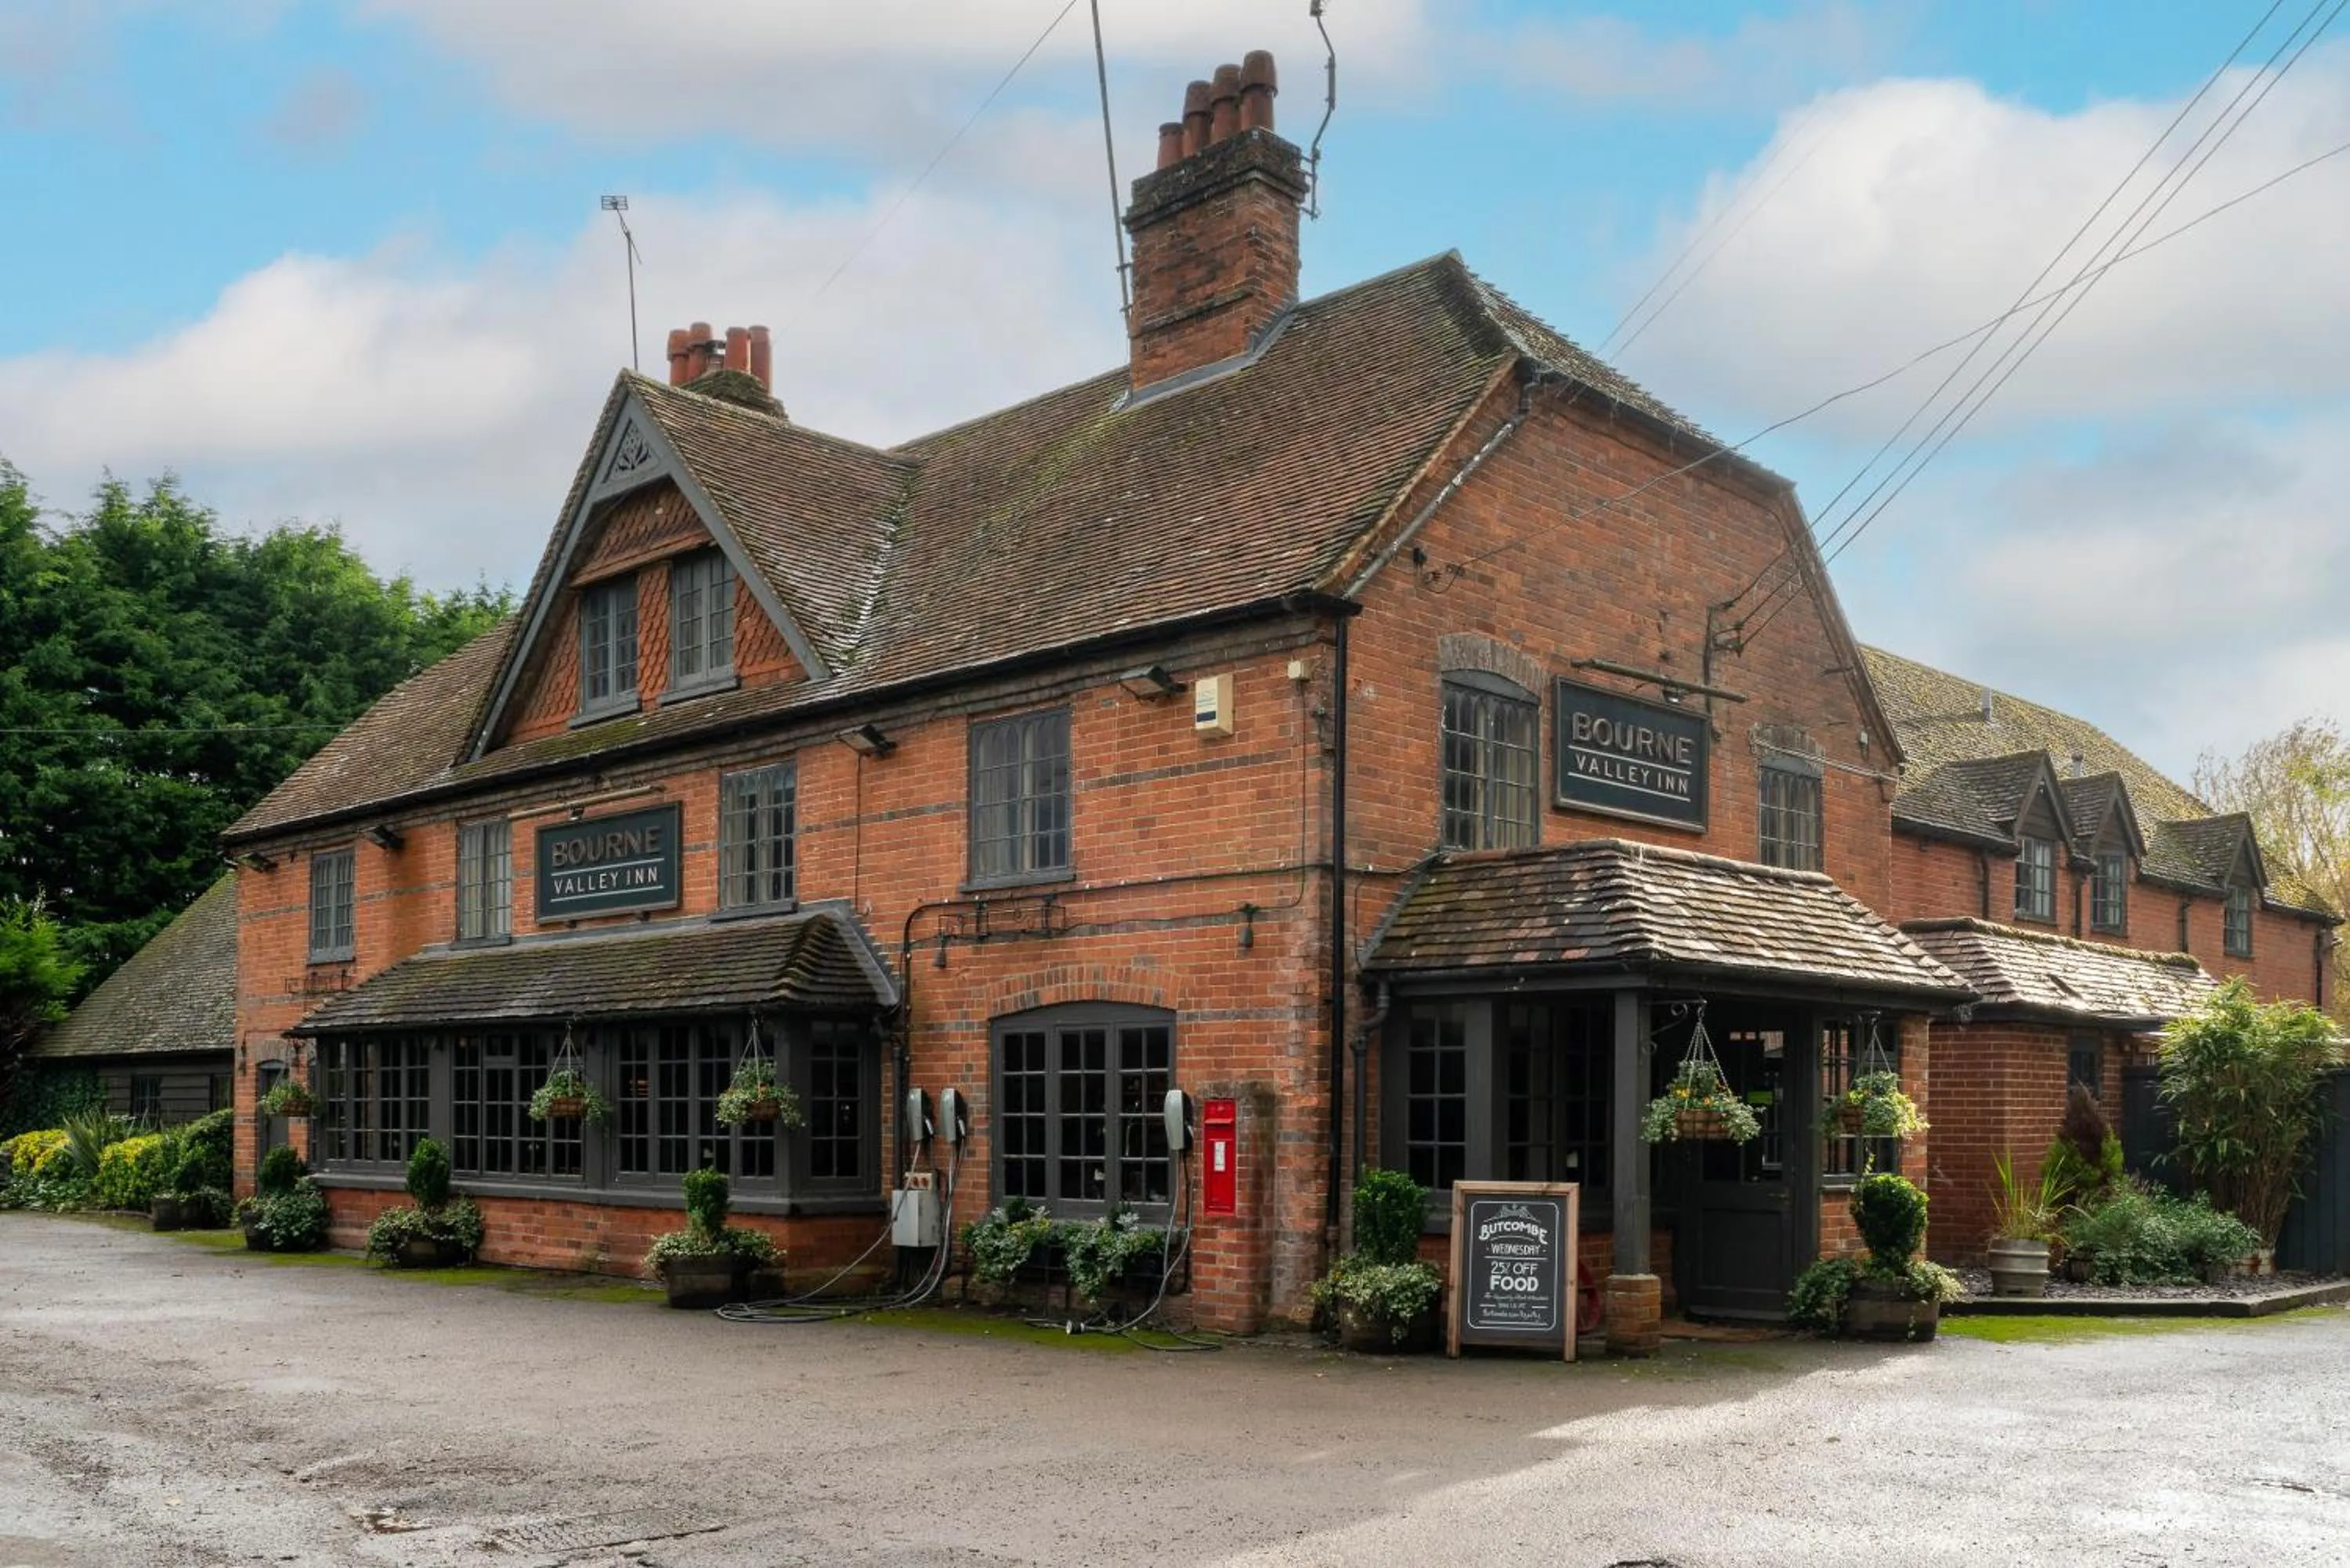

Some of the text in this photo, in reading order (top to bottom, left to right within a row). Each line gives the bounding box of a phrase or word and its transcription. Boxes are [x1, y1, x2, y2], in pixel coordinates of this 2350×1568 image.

[1572, 712, 1694, 764] BOURNE
[1576, 754, 1688, 793] VALLEY INN
[551, 826, 661, 867] BOURNE
[554, 866, 657, 894] VALLEY INN
[1478, 1221, 1548, 1245] BUTCOMBE
[1491, 1244, 1541, 1255] WEDNESDAY
[1491, 1260, 1538, 1275] 25% OFF
[1490, 1275, 1538, 1292] FOOD
